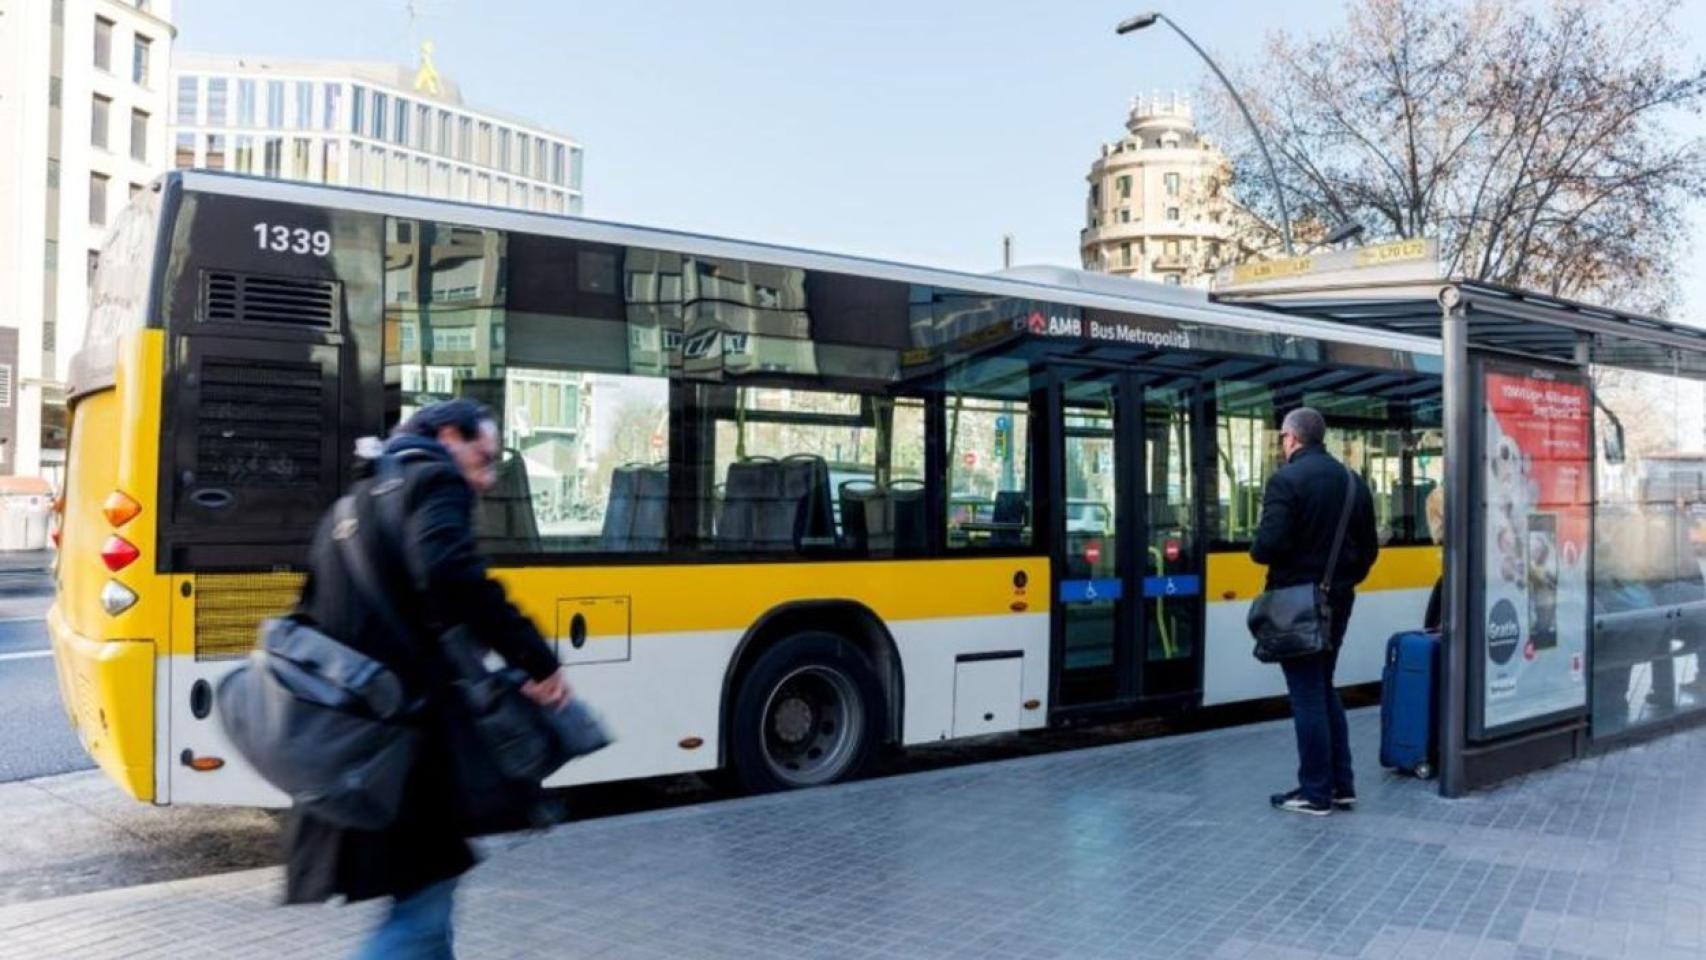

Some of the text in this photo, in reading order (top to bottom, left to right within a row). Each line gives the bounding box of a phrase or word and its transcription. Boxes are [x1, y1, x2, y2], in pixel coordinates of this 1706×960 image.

[253, 222, 331, 257] 1339
[1380, 246, 1400, 259] L70
[1403, 243, 1423, 256] L72
[1049, 316, 1190, 349] AMB Bus Metropolità
